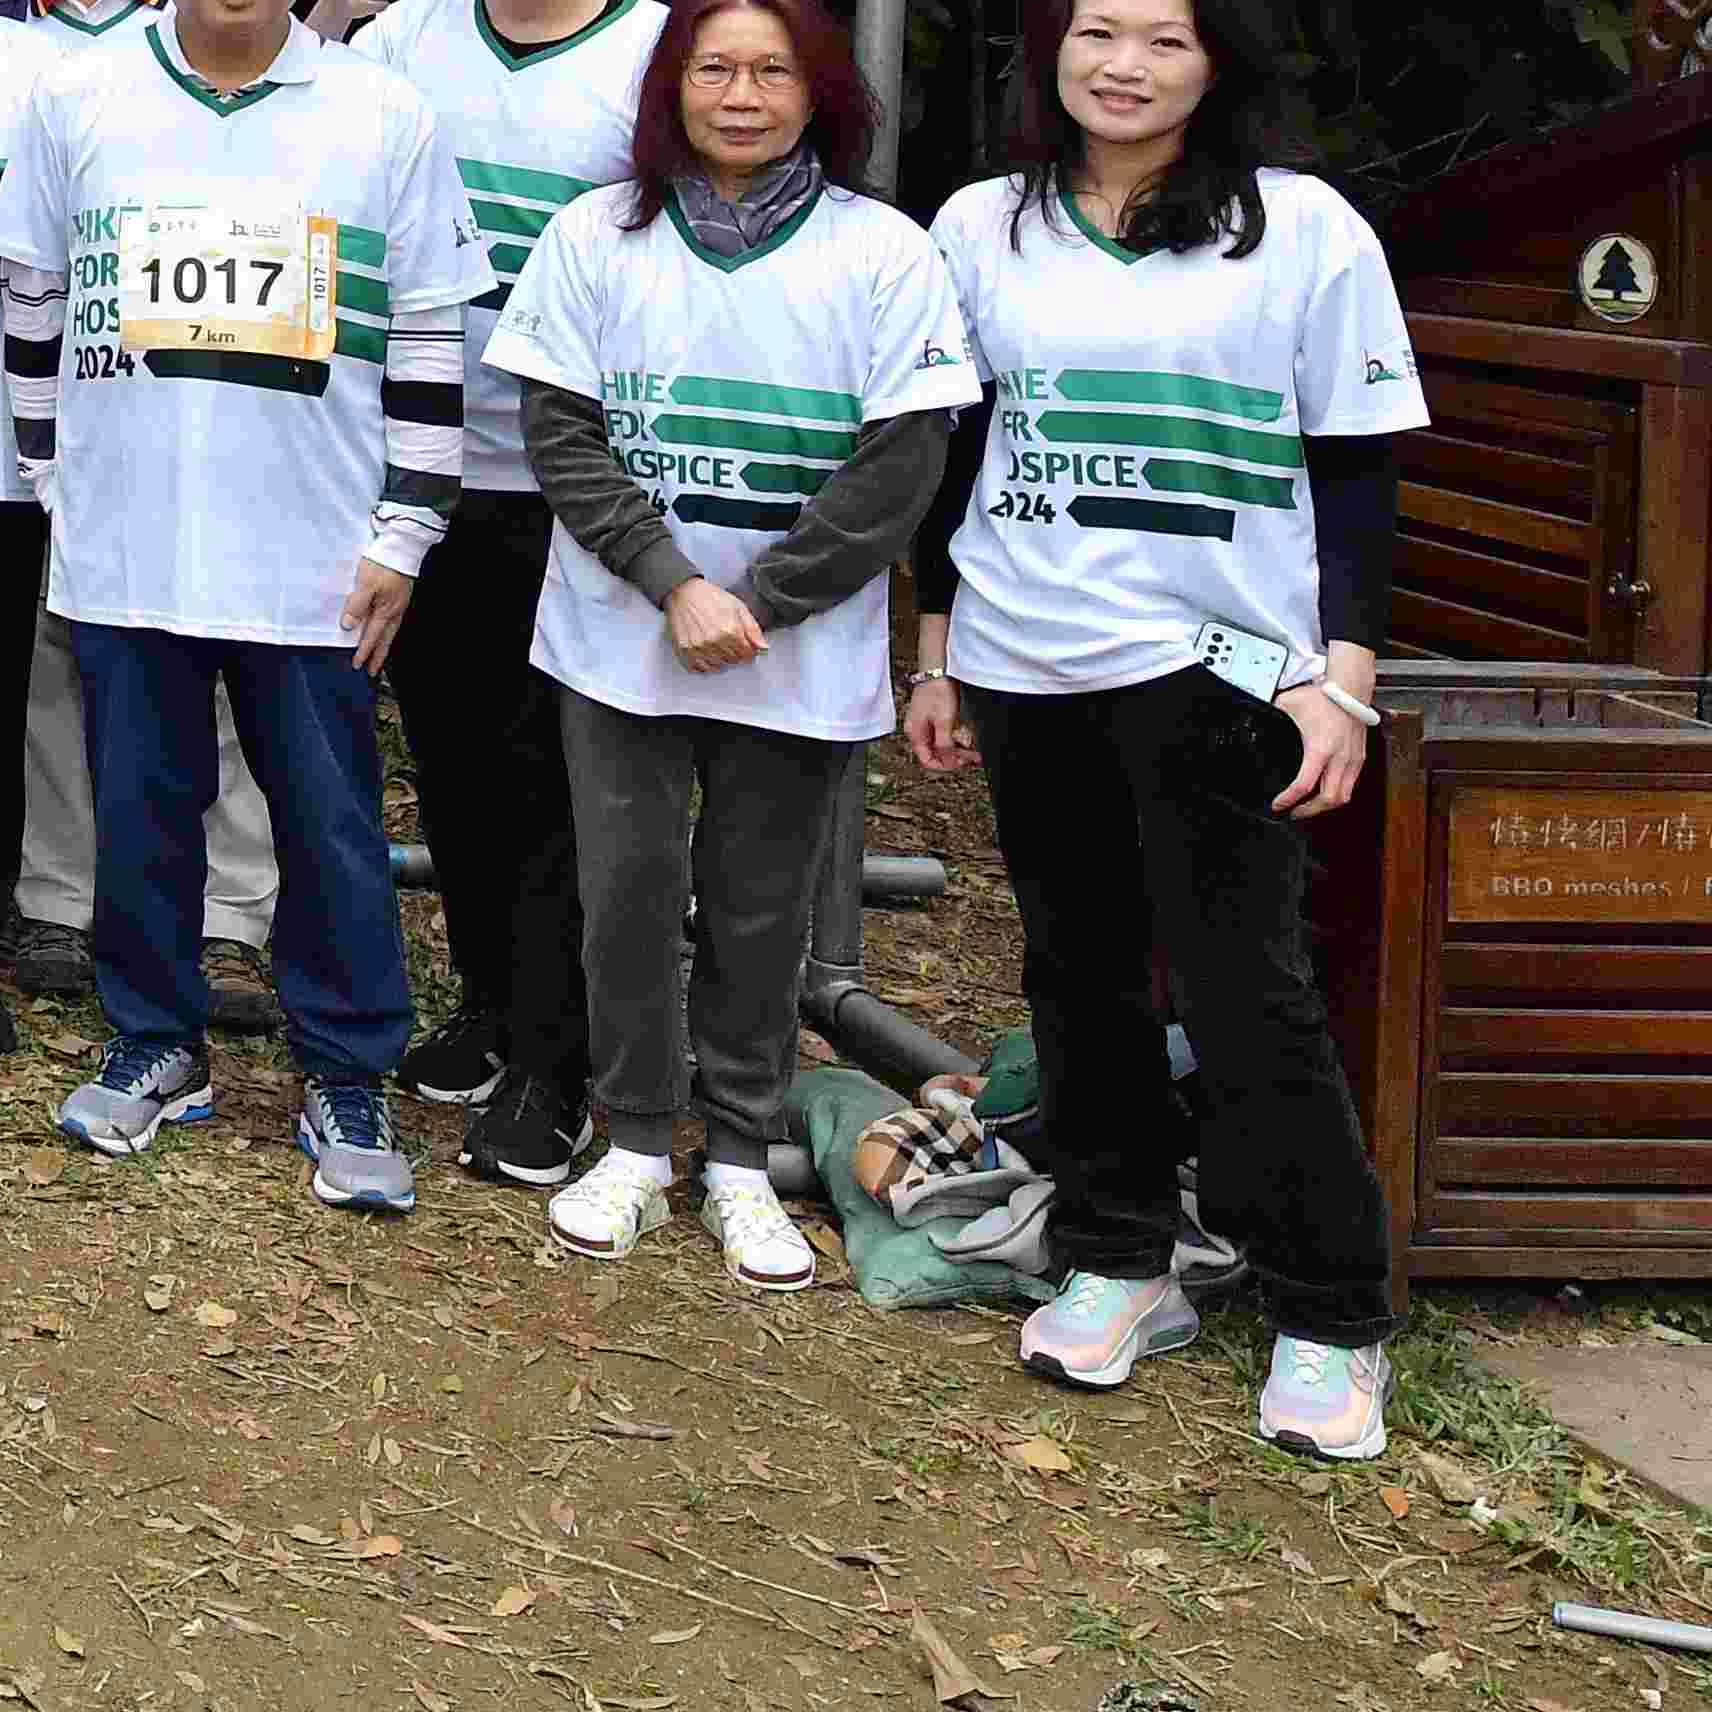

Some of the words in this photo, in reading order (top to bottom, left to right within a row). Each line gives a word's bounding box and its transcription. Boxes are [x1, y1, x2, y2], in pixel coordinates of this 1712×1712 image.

[141, 256, 285, 307] 1017
[312, 265, 328, 301] 1017
[187, 324, 203, 342] 7
[207, 328, 236, 344] km
[74, 344, 136, 381] 2024
